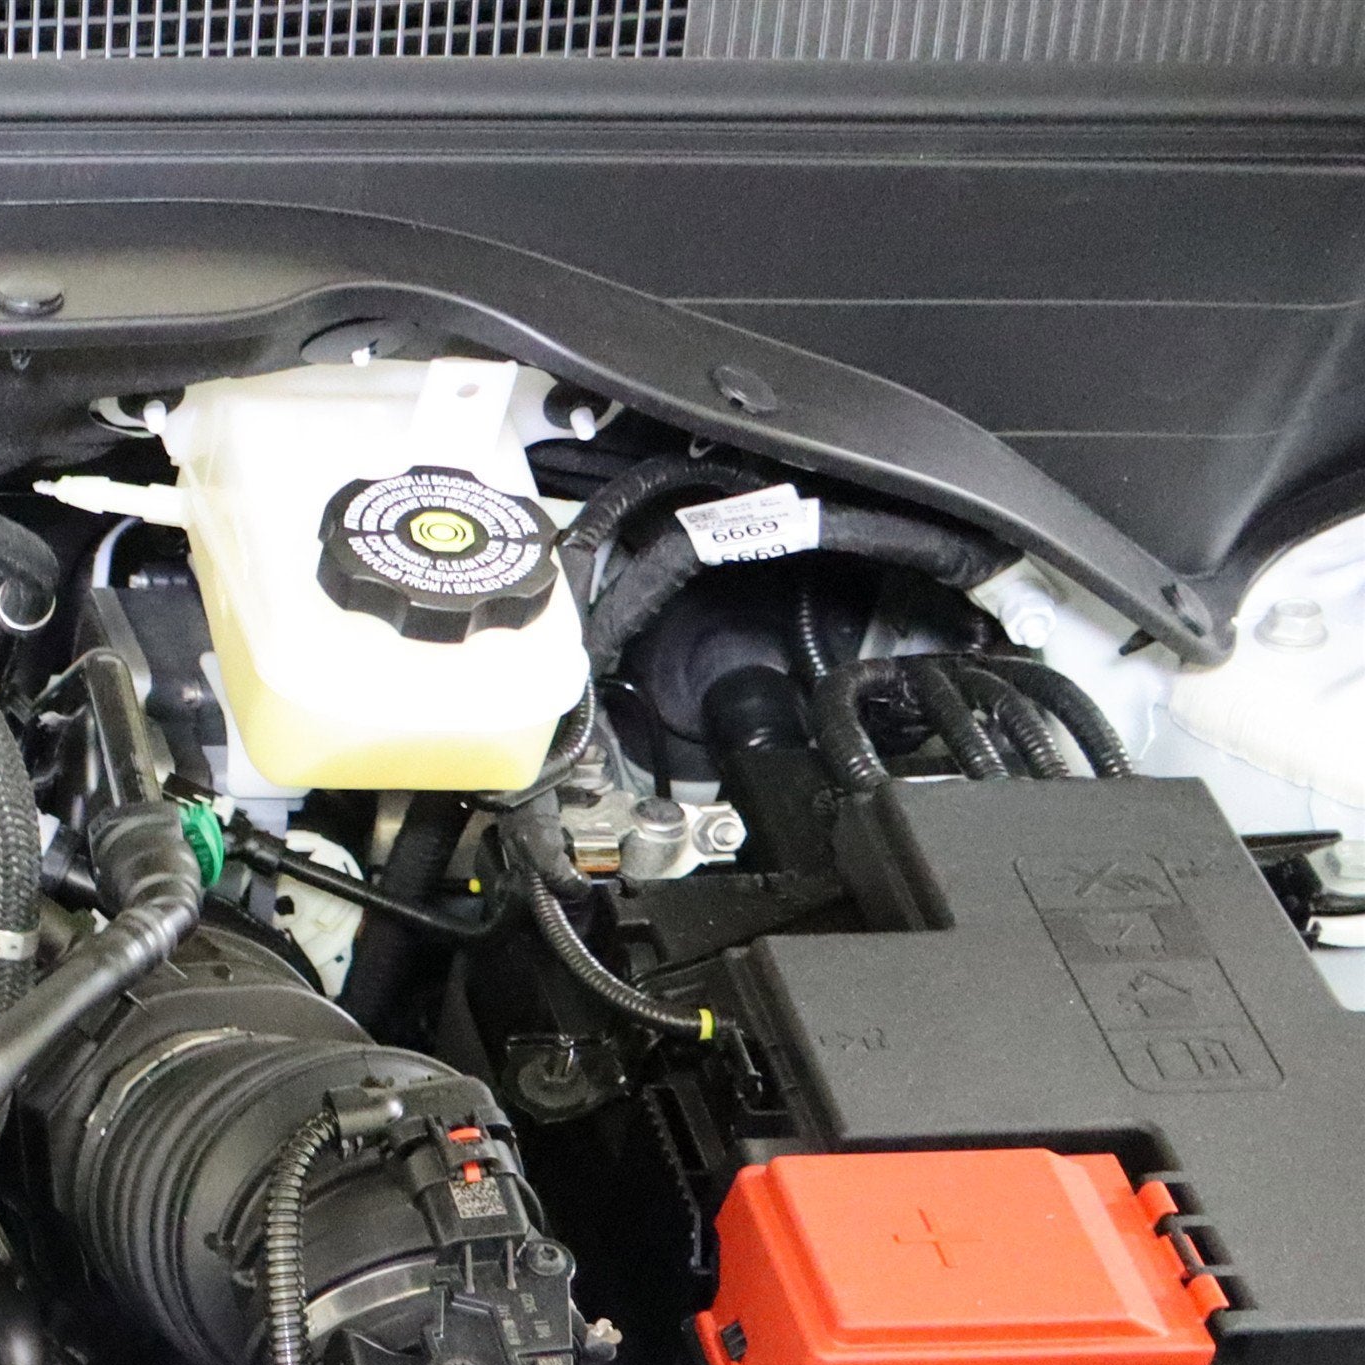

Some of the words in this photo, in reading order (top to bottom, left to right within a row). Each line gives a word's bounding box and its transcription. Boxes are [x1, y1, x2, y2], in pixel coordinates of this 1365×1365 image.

[413, 474, 430, 483] LE
[712, 520, 778, 543] 6669
[434, 559, 482, 572] CLEAN
[364, 557, 403, 581] FLUID
[398, 574, 440, 593] FROM
[442, 584, 452, 594] A
[452, 578, 506, 594] SEALED
